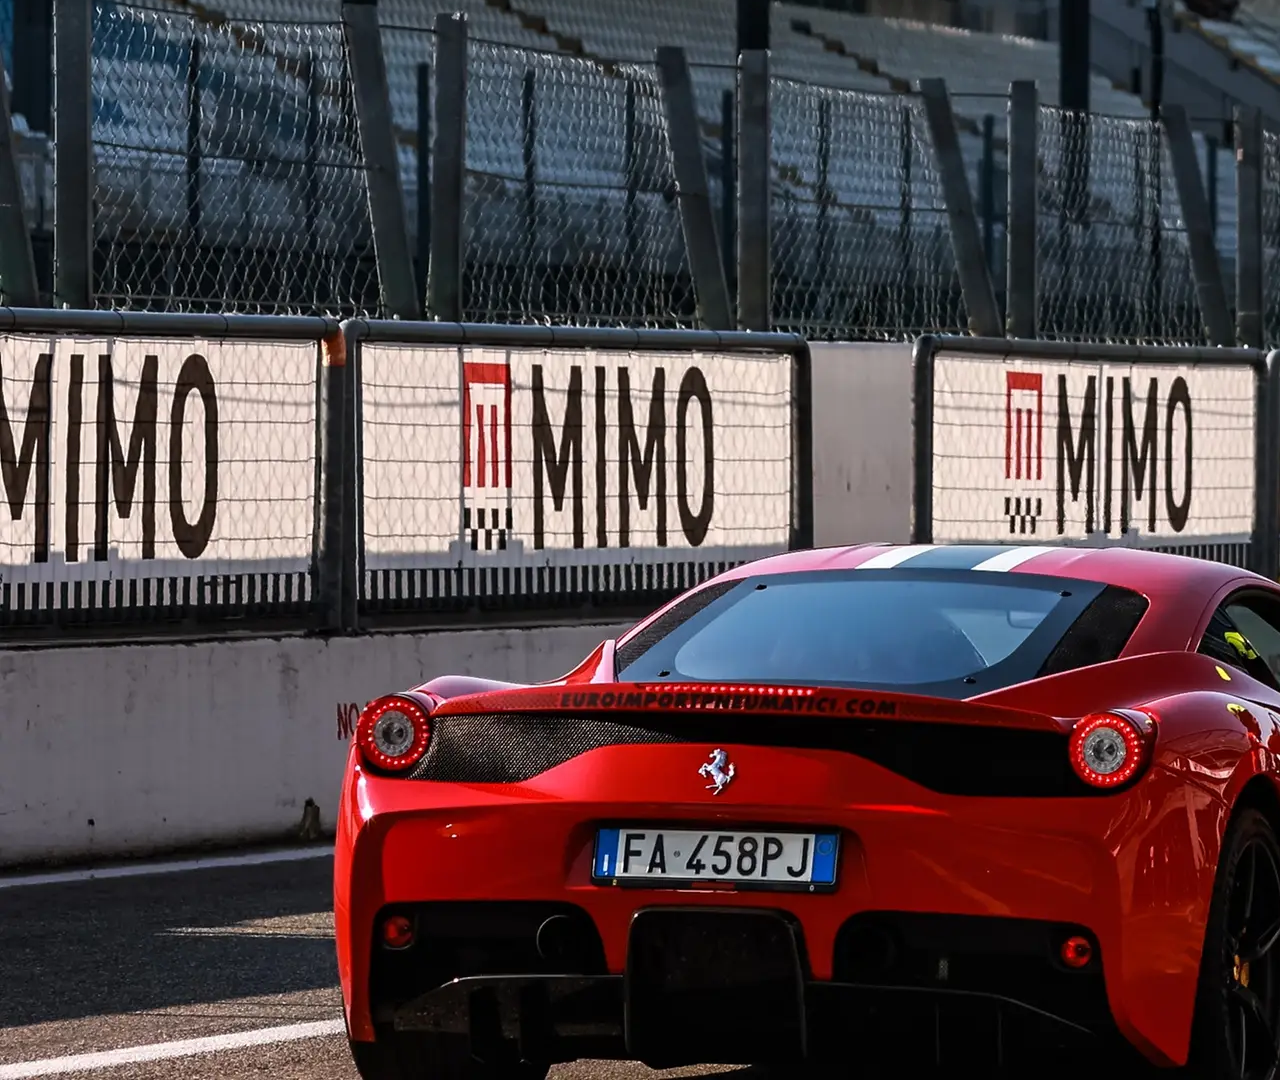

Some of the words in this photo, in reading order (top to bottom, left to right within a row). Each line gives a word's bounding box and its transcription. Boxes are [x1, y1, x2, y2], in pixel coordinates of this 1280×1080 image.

[0, 353, 218, 562] MIMO
[532, 365, 714, 549] MIMO
[1057, 373, 1192, 535] MIMO
[560, 691, 897, 716] EUROIMPORTPNEUMATICI.COM
[622, 833, 667, 874] FA
[686, 834, 810, 878] 458PJ
